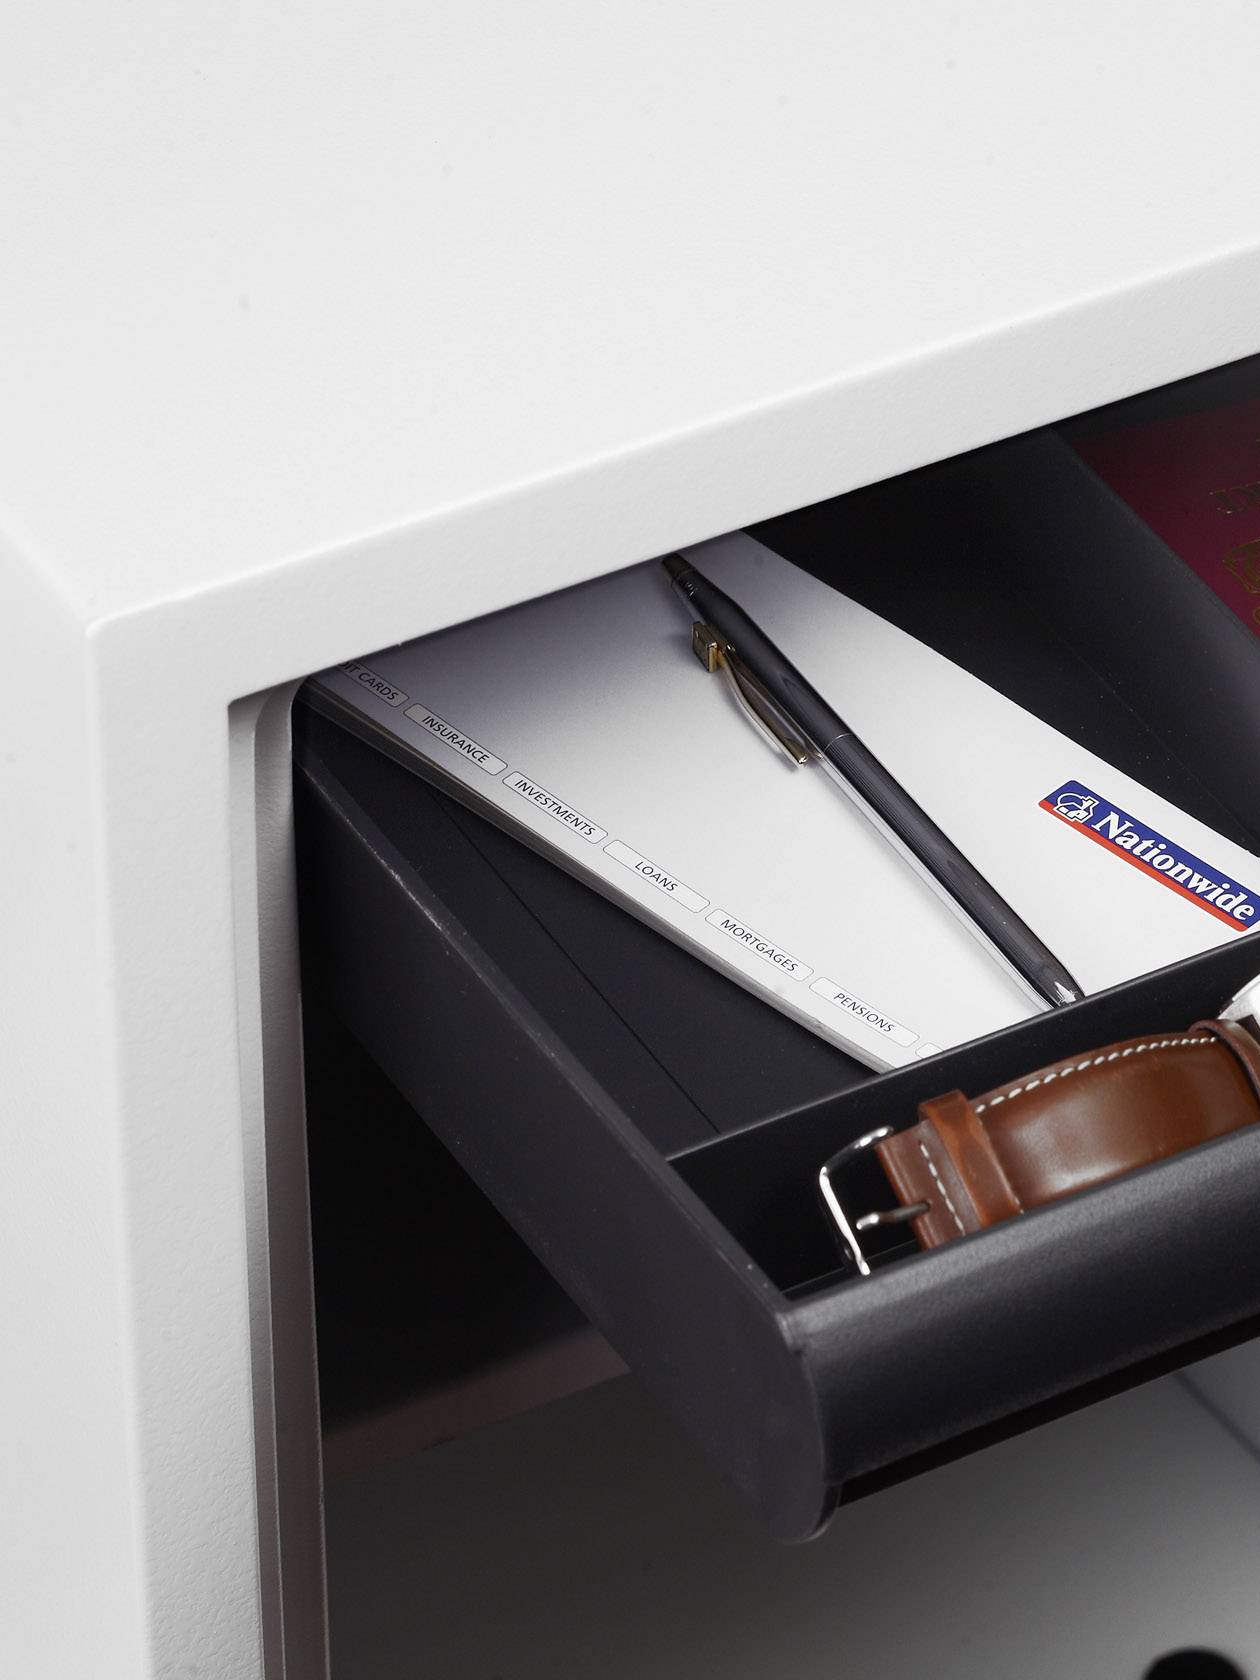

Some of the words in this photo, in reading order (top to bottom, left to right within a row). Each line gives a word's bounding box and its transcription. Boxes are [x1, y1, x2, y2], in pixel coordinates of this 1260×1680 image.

[359, 672, 399, 700] CARDS
[421, 715, 490, 764] INSURANCE
[514, 779, 596, 837] INVESTMENTS
[634, 860, 679, 893] LOANS
[1091, 811, 1256, 922] Nationwide
[720, 918, 799, 974] MORTGAGES
[833, 992, 895, 1033] PENSIONS
